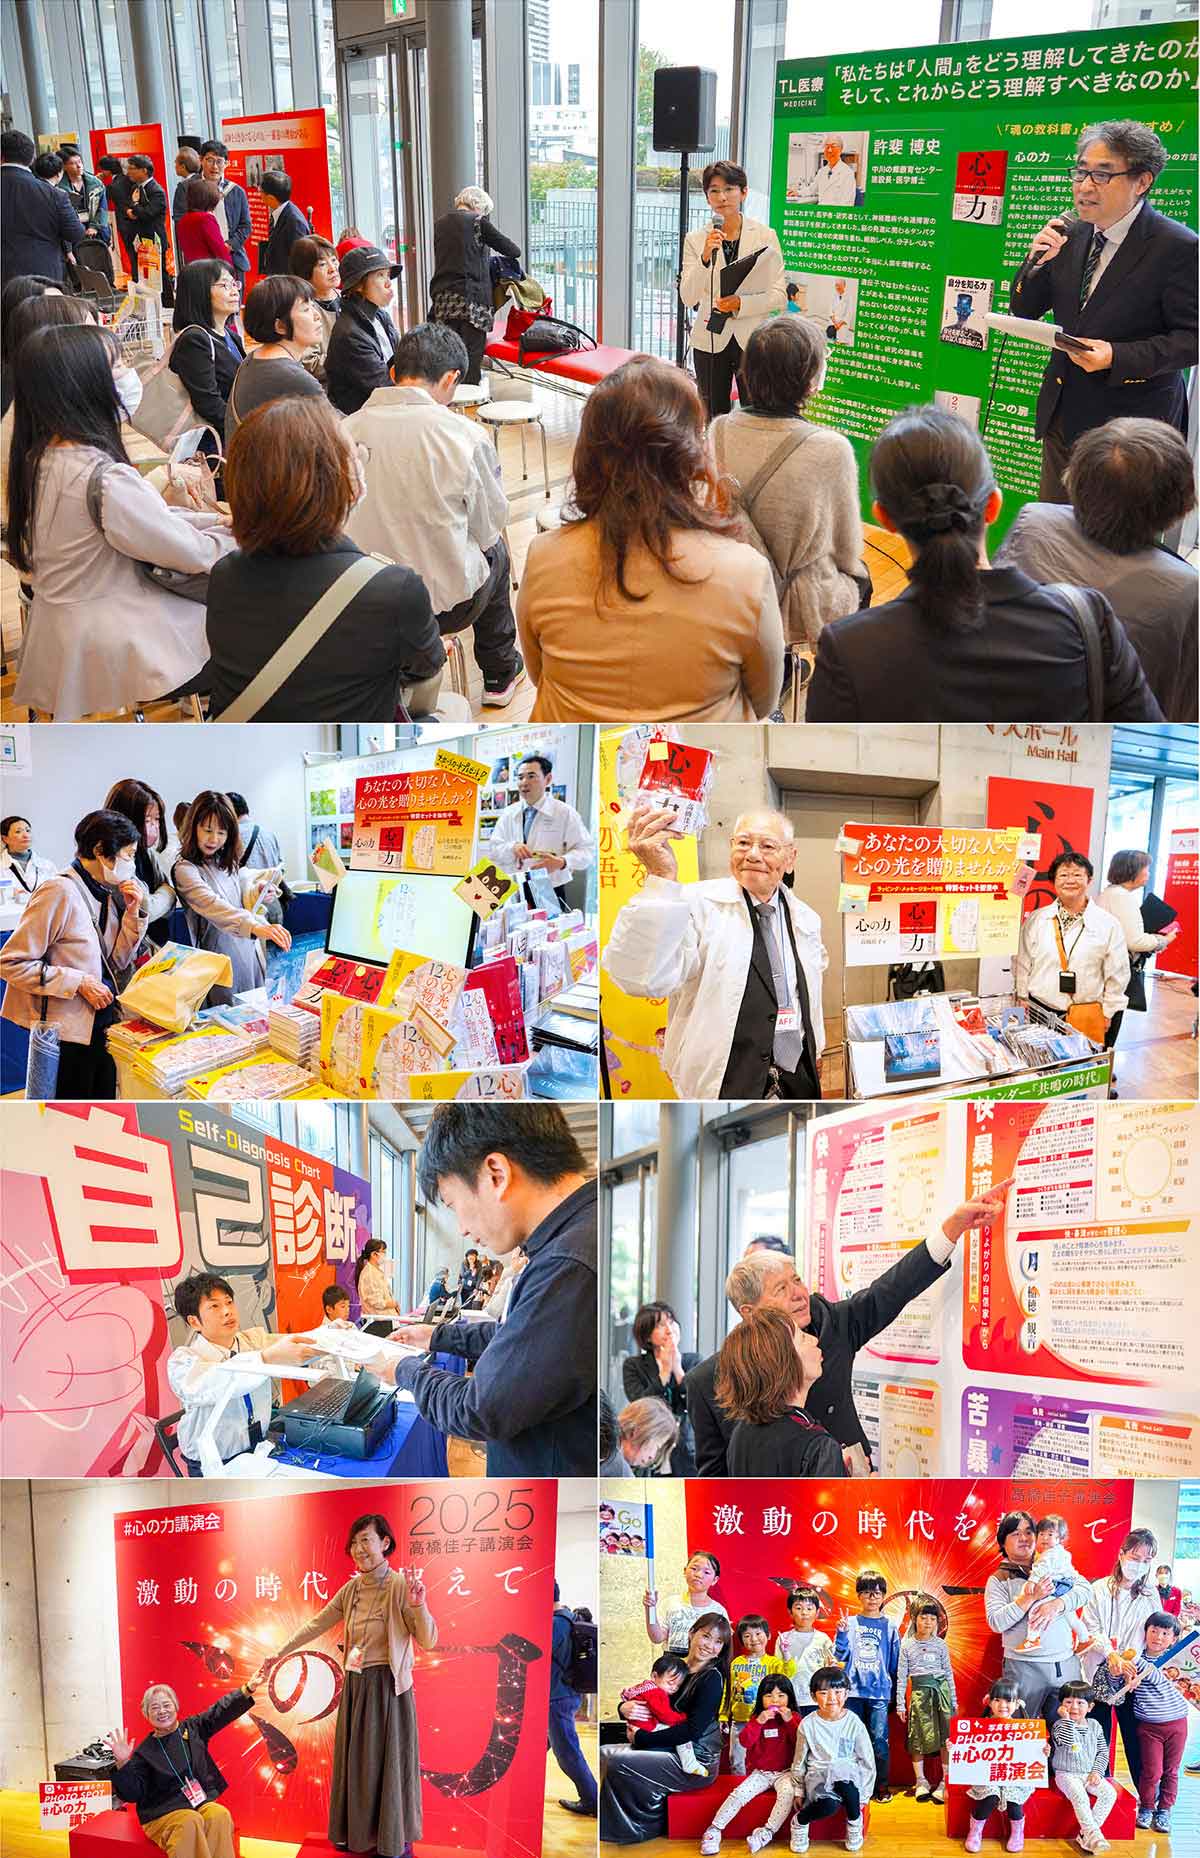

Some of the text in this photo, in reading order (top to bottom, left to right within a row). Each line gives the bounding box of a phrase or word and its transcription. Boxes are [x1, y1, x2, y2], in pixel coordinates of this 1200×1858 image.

[779, 75, 824, 95] TL医療
[783, 99, 817, 108] MEDICINE
[909, 138, 941, 156] 博史
[1014, 151, 1050, 164] 心の力
[948, 278, 988, 291] 自分を知る力
[1027, 745, 1078, 763] Main Hall
[363, 772, 467, 794] あなたの大切な人へ
[356, 788, 474, 811] 心の光を贈りませんか？
[355, 838, 376, 849] 心の力
[864, 832, 1013, 855] あなたの大切な人へ
[853, 857, 1020, 878] 心の光を贈りませんか？
[855, 917, 891, 933] 心の力
[177, 1108, 321, 1180] Self-Diagnosis Chart
[44, 1104, 358, 1274] 自己診断
[1028, 1252, 1039, 1272] 月
[408, 1488, 535, 1537] 2025
[123, 1513, 221, 1537] #心の力講演会
[408, 1536, 534, 1556] 高橋佳子講演会
[135, 1565, 526, 1606] 激動の時代超えて
[956, 1731, 1041, 1745] PHOTO SPOT
[951, 1743, 1014, 1764] #心の力
[989, 1761, 1046, 1782] 講演会
[44, 1789, 105, 1803] PHOTO SPOT
[43, 1800, 87, 1816] #心の力
